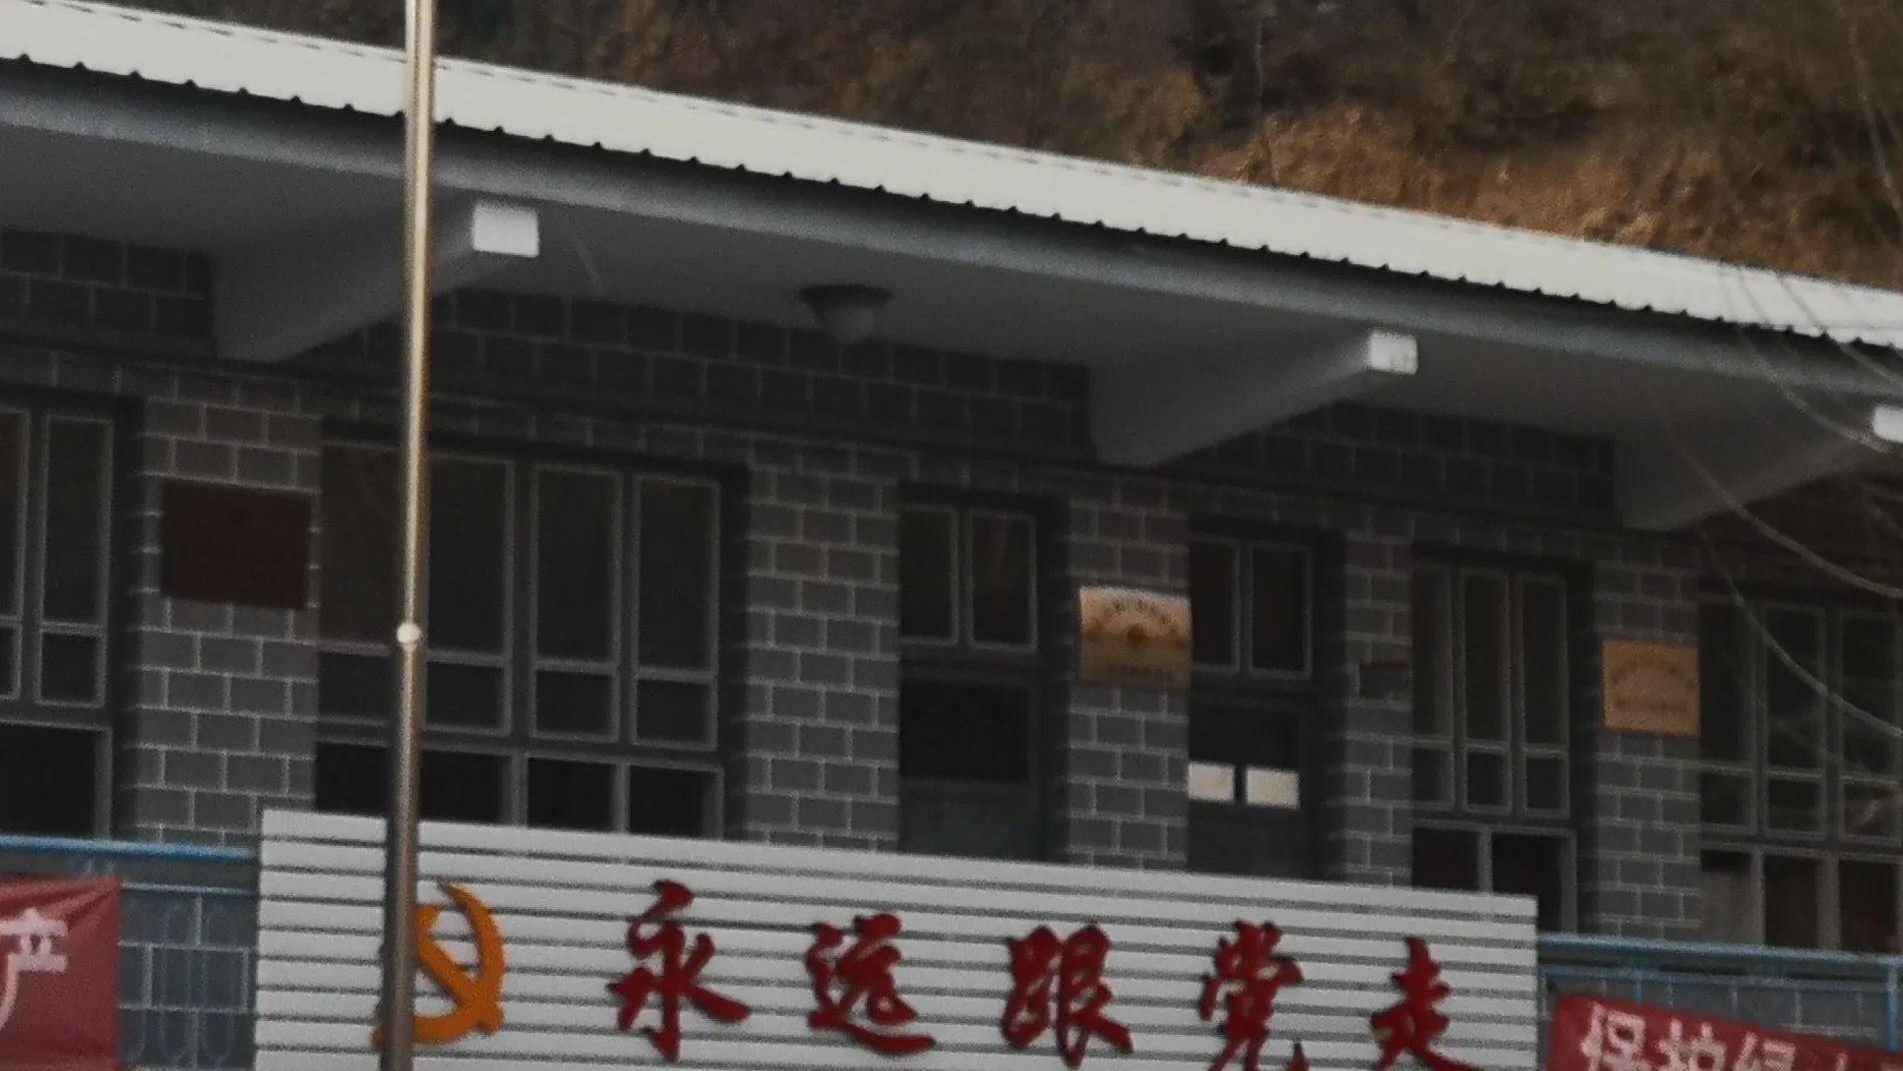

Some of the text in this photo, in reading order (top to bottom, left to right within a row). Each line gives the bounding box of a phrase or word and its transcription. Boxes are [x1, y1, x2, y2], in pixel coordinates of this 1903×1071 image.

[607, 879, 1485, 1071] 永远跟党走
